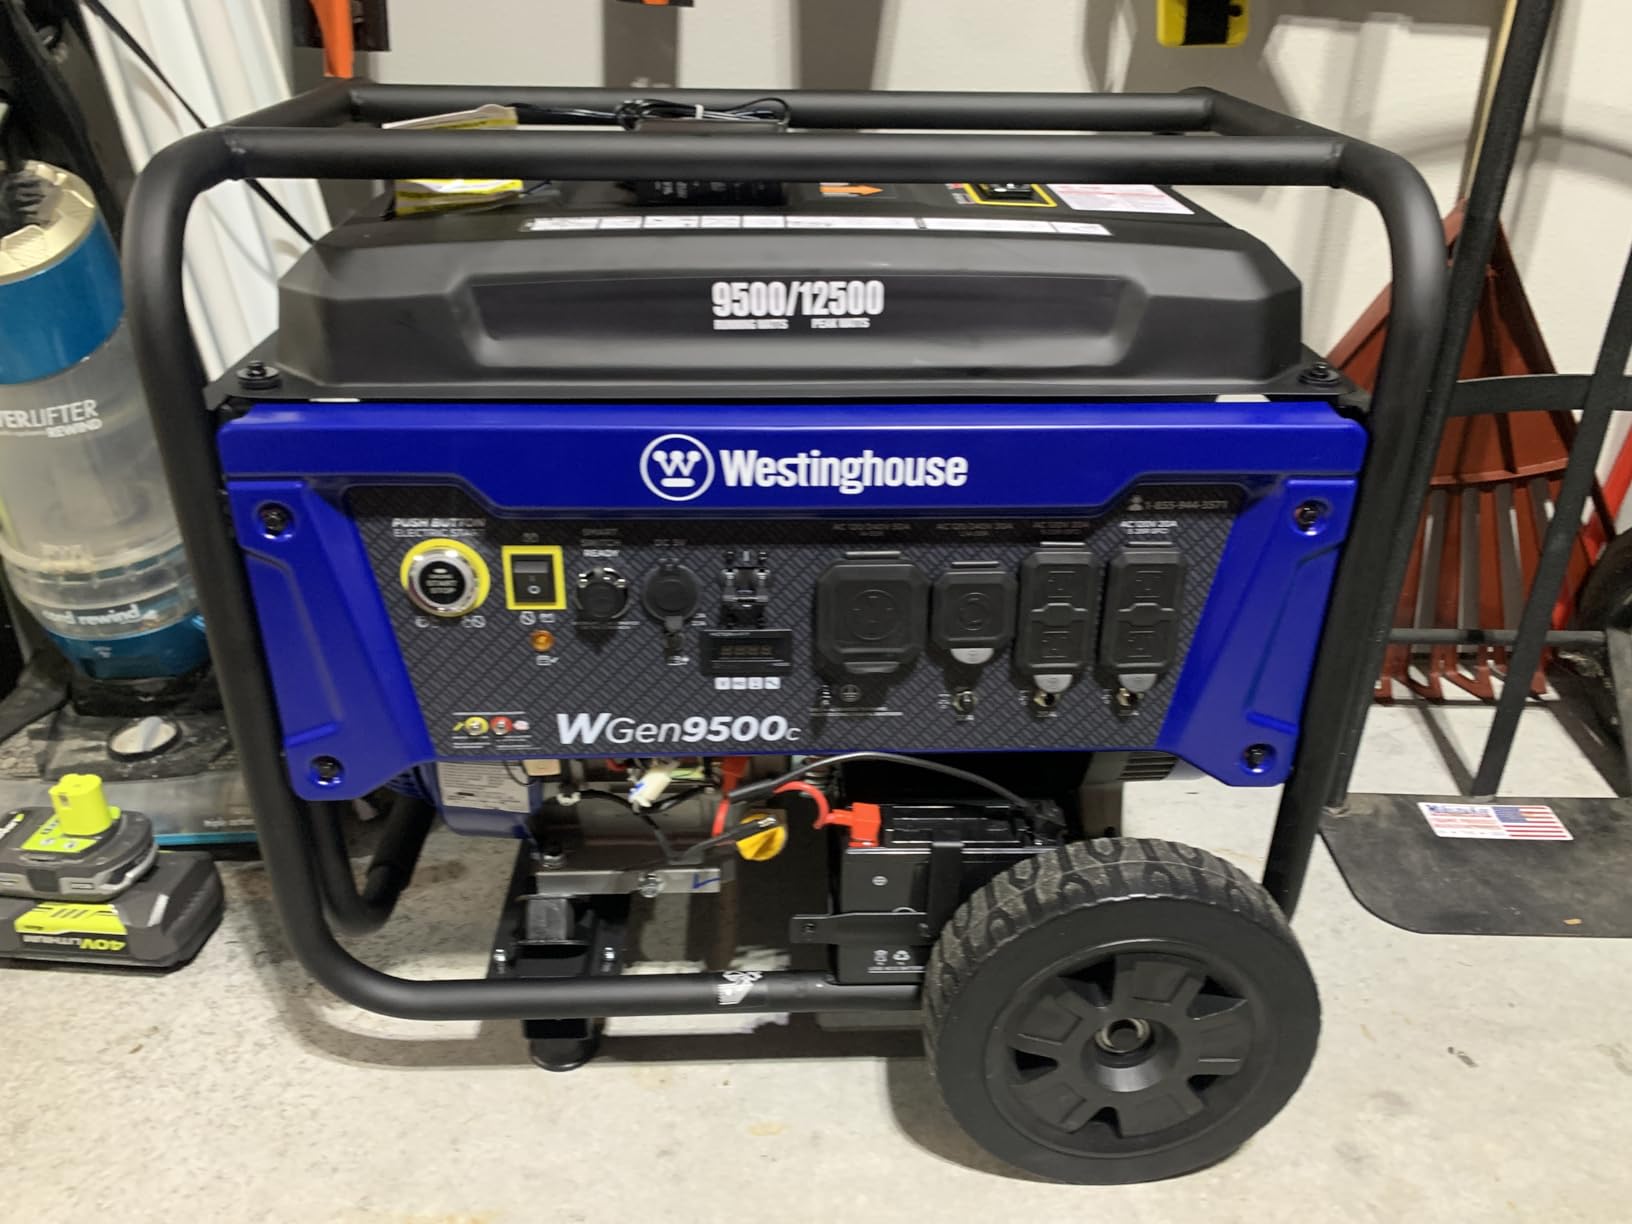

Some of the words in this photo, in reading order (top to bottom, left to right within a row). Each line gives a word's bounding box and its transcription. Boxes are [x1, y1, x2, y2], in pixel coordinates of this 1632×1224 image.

[711, 280, 885, 317] 9500/12500
[0, 399, 99, 428] ERLIFTER
[719, 449, 969, 494] Westinghouse
[556, 712, 802, 745] WGen9500c
